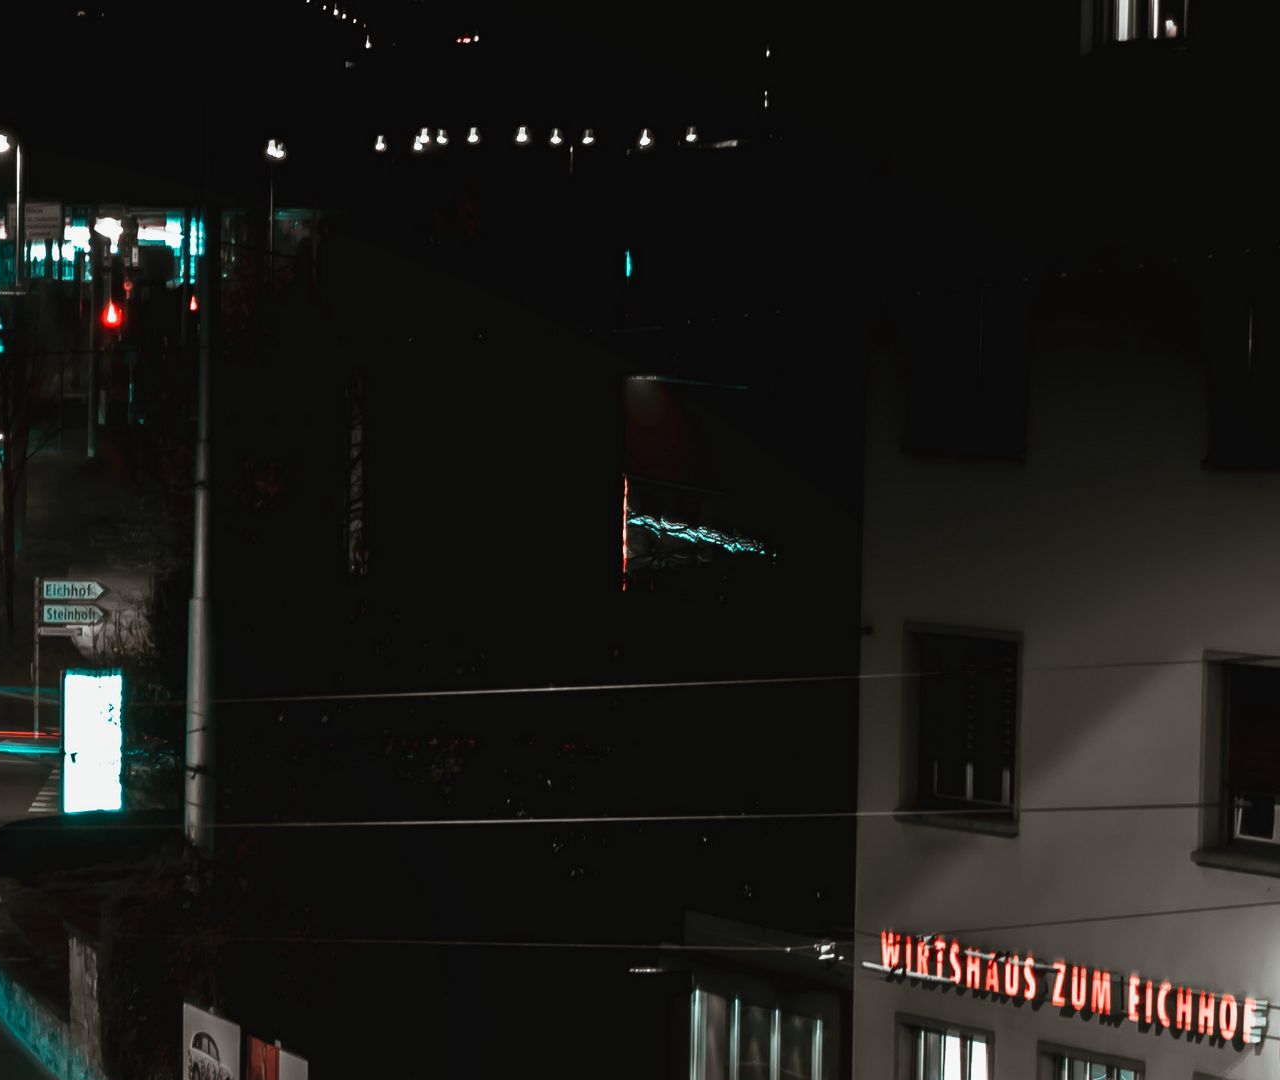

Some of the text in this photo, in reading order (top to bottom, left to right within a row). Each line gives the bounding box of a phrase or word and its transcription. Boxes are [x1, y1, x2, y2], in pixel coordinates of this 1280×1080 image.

[45, 583, 92, 597] Eichhof
[880, 929, 1262, 1044] WIRTSHAUS ZUM EICHHOF
